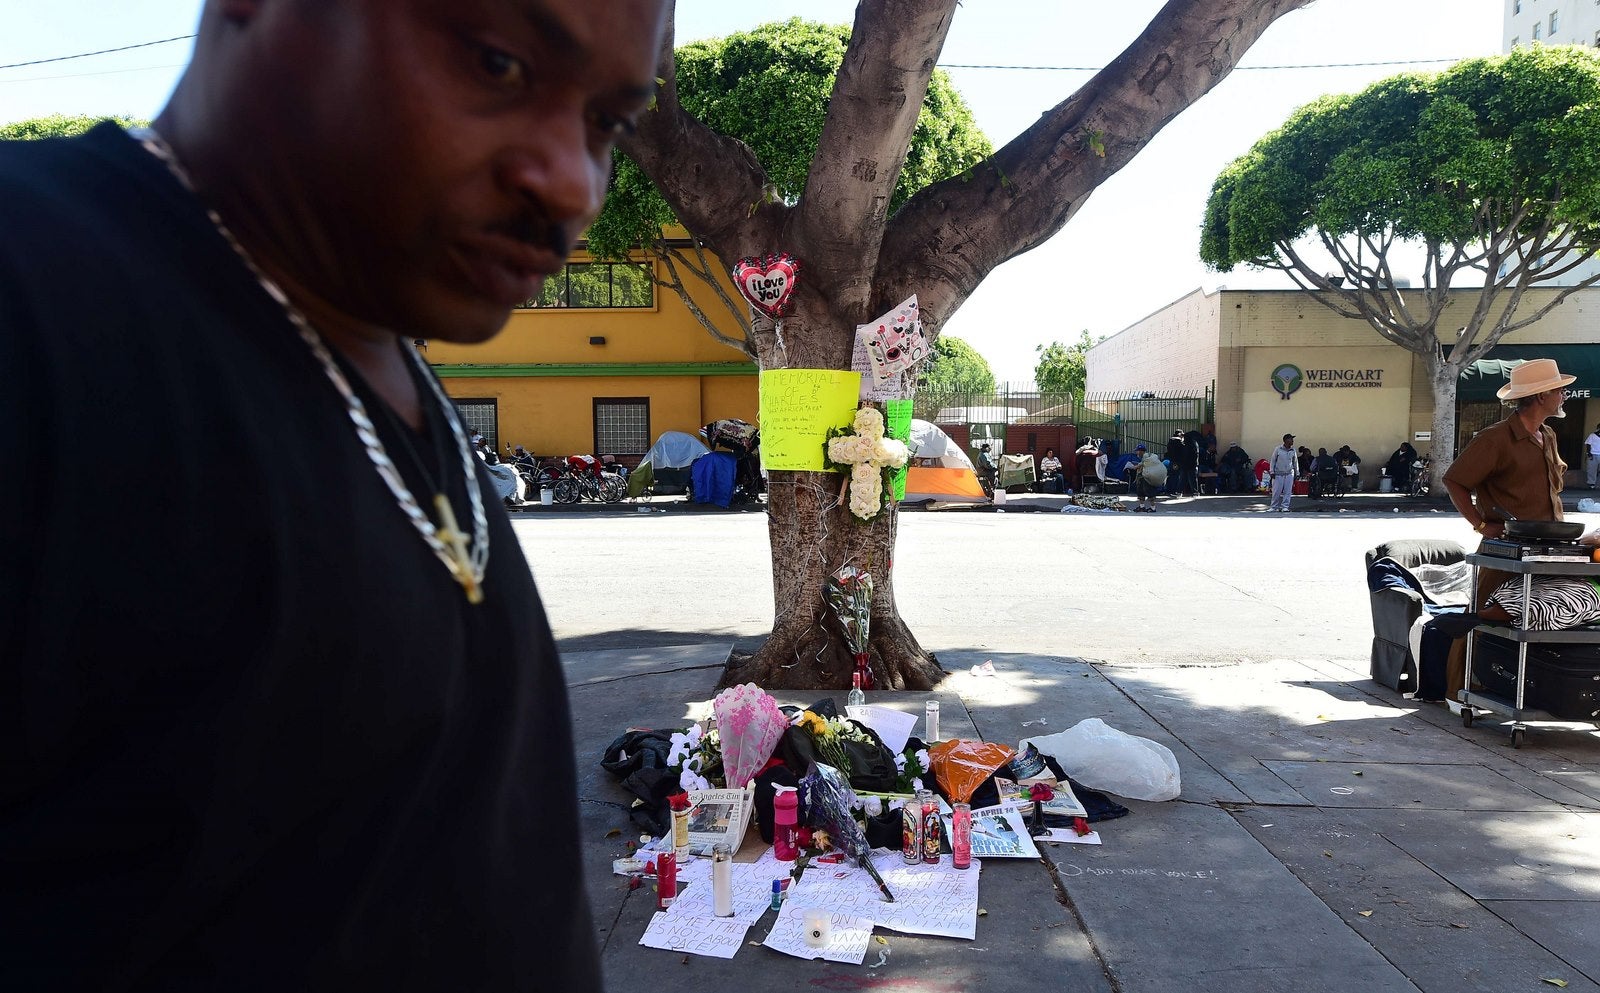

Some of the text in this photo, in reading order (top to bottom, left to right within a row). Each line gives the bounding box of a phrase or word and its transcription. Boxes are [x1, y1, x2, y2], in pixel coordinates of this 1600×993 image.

[1306, 369, 1384, 381] WEINGART
[1565, 389, 1591, 398] CAFE
[981, 807, 1003, 817] APRIL
[667, 925, 706, 939] NOT
[704, 933, 742, 948] ABOUT
